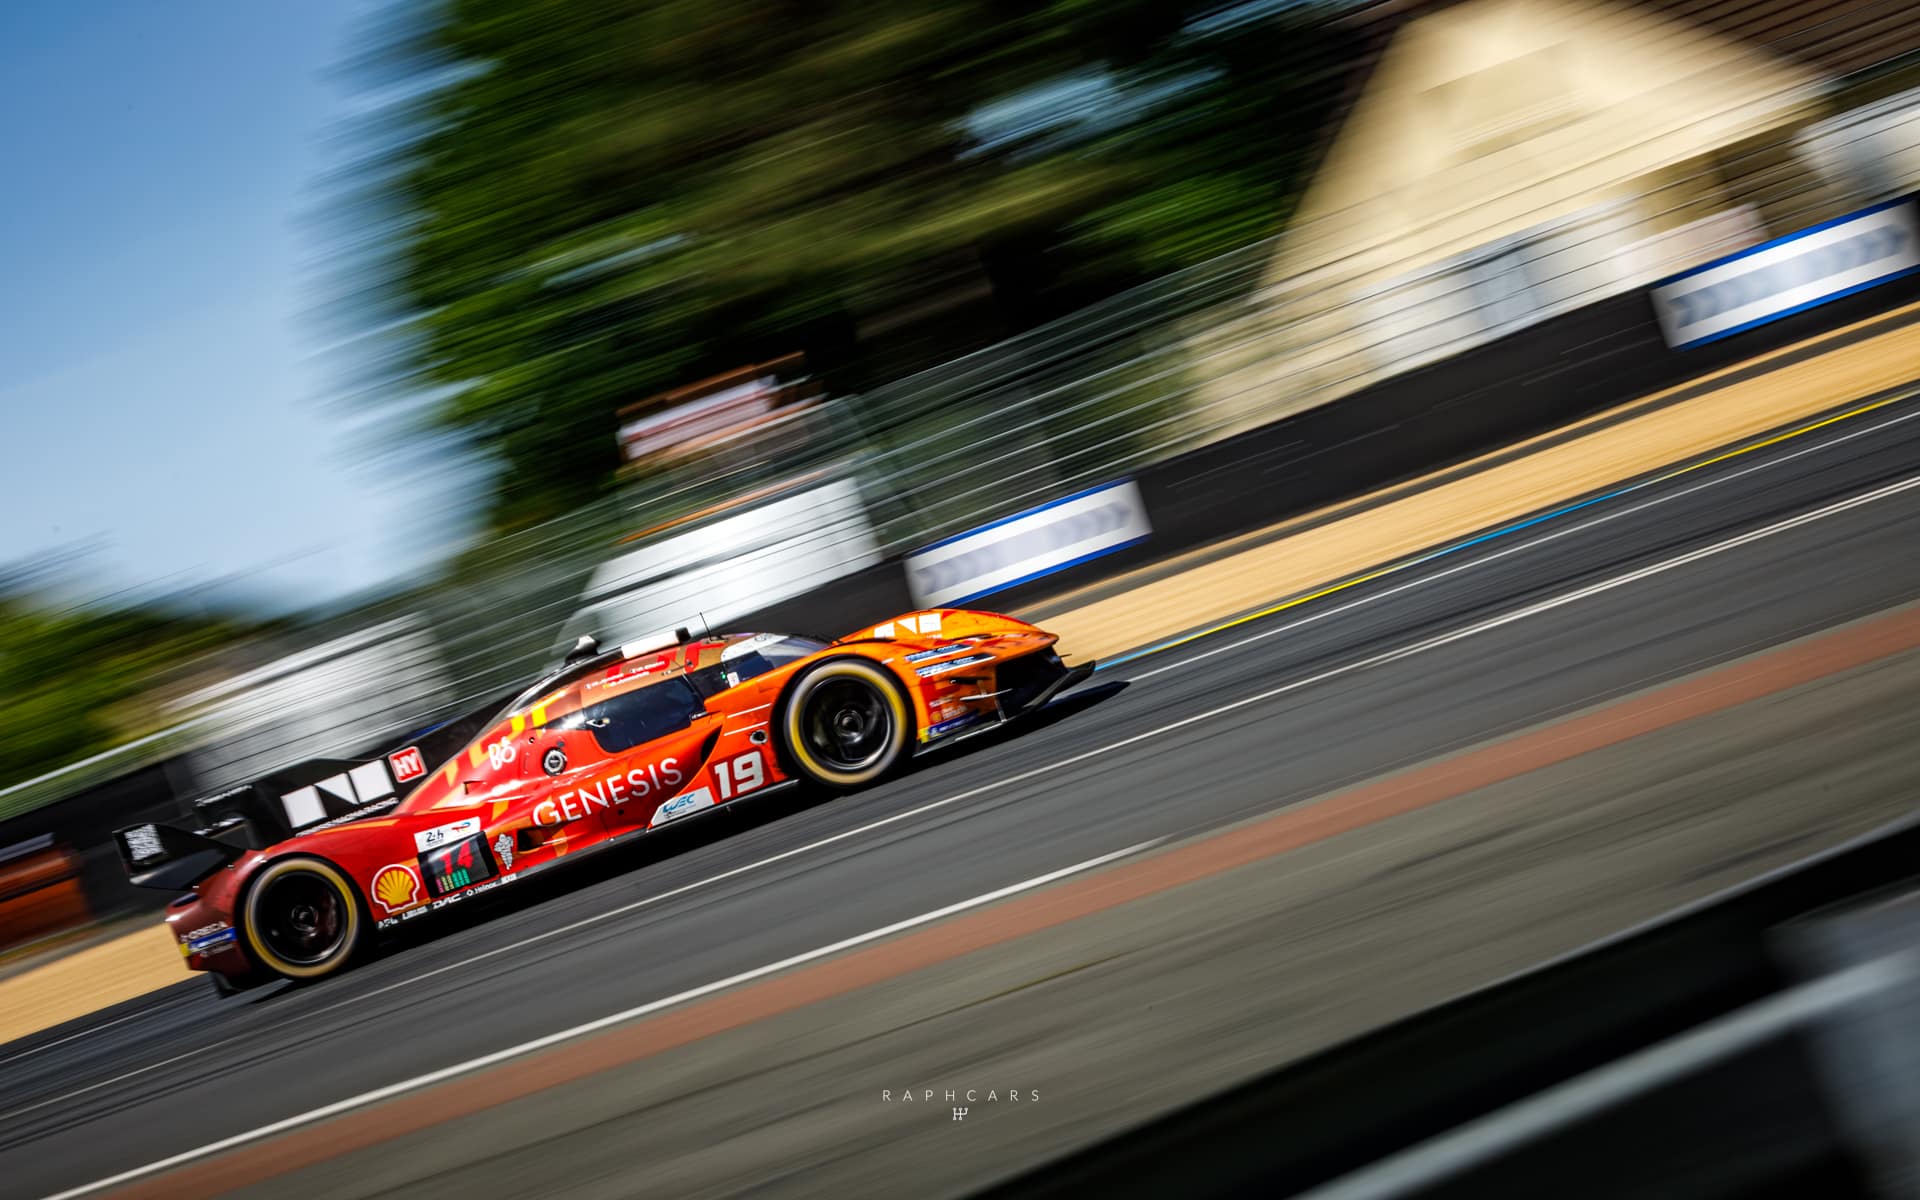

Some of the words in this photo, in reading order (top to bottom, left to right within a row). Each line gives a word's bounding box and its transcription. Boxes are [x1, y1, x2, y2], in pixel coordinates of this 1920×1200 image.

[393, 752, 420, 777] HY
[714, 750, 764, 800] 19
[532, 757, 683, 827] GENESIS
[662, 793, 696, 813] WEC
[439, 841, 474, 876] 14
